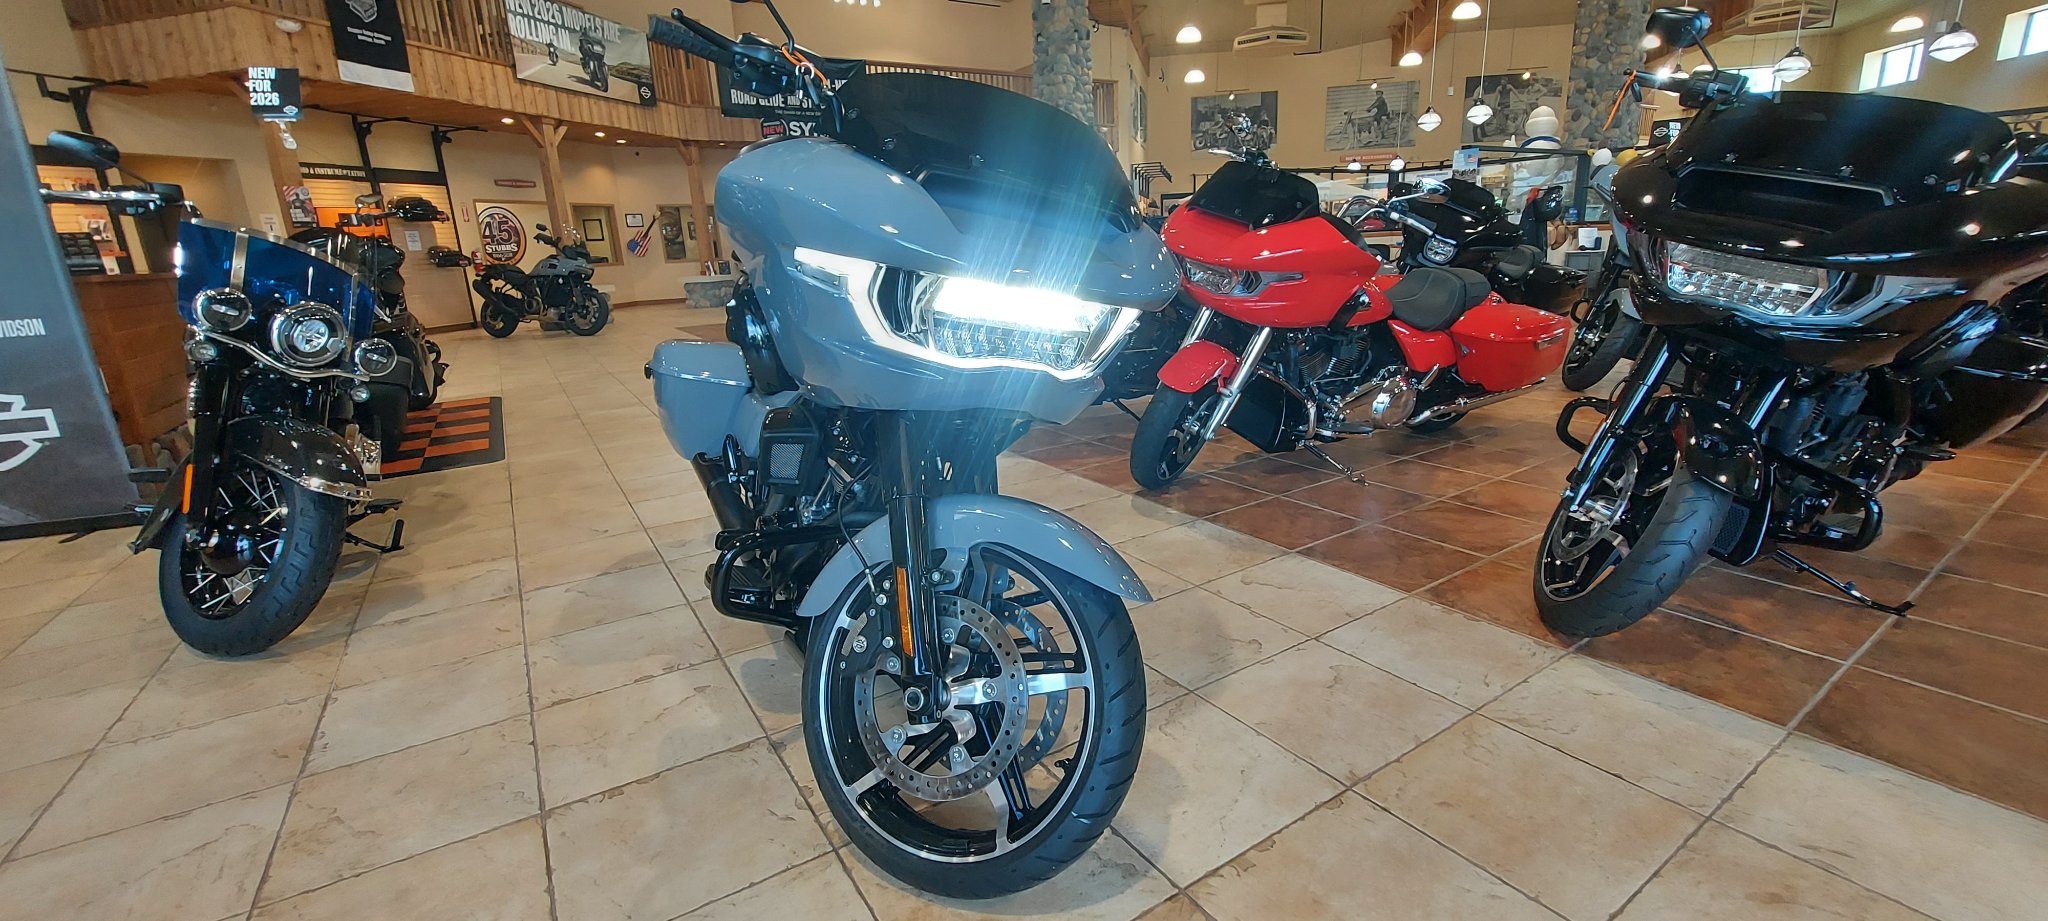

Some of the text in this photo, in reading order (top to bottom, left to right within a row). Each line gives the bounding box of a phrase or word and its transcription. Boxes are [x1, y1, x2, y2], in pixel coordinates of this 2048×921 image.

[506, 0, 621, 41] NEW 2026 MODELS ARE
[507, 12, 557, 47] ROLLING
[248, 67, 276, 79] NEW
[249, 80, 272, 91] FOR
[250, 92, 280, 106] 2026
[763, 124, 785, 136] NEW
[482, 219, 513, 245] 45
[485, 243, 519, 254] STUBBS
